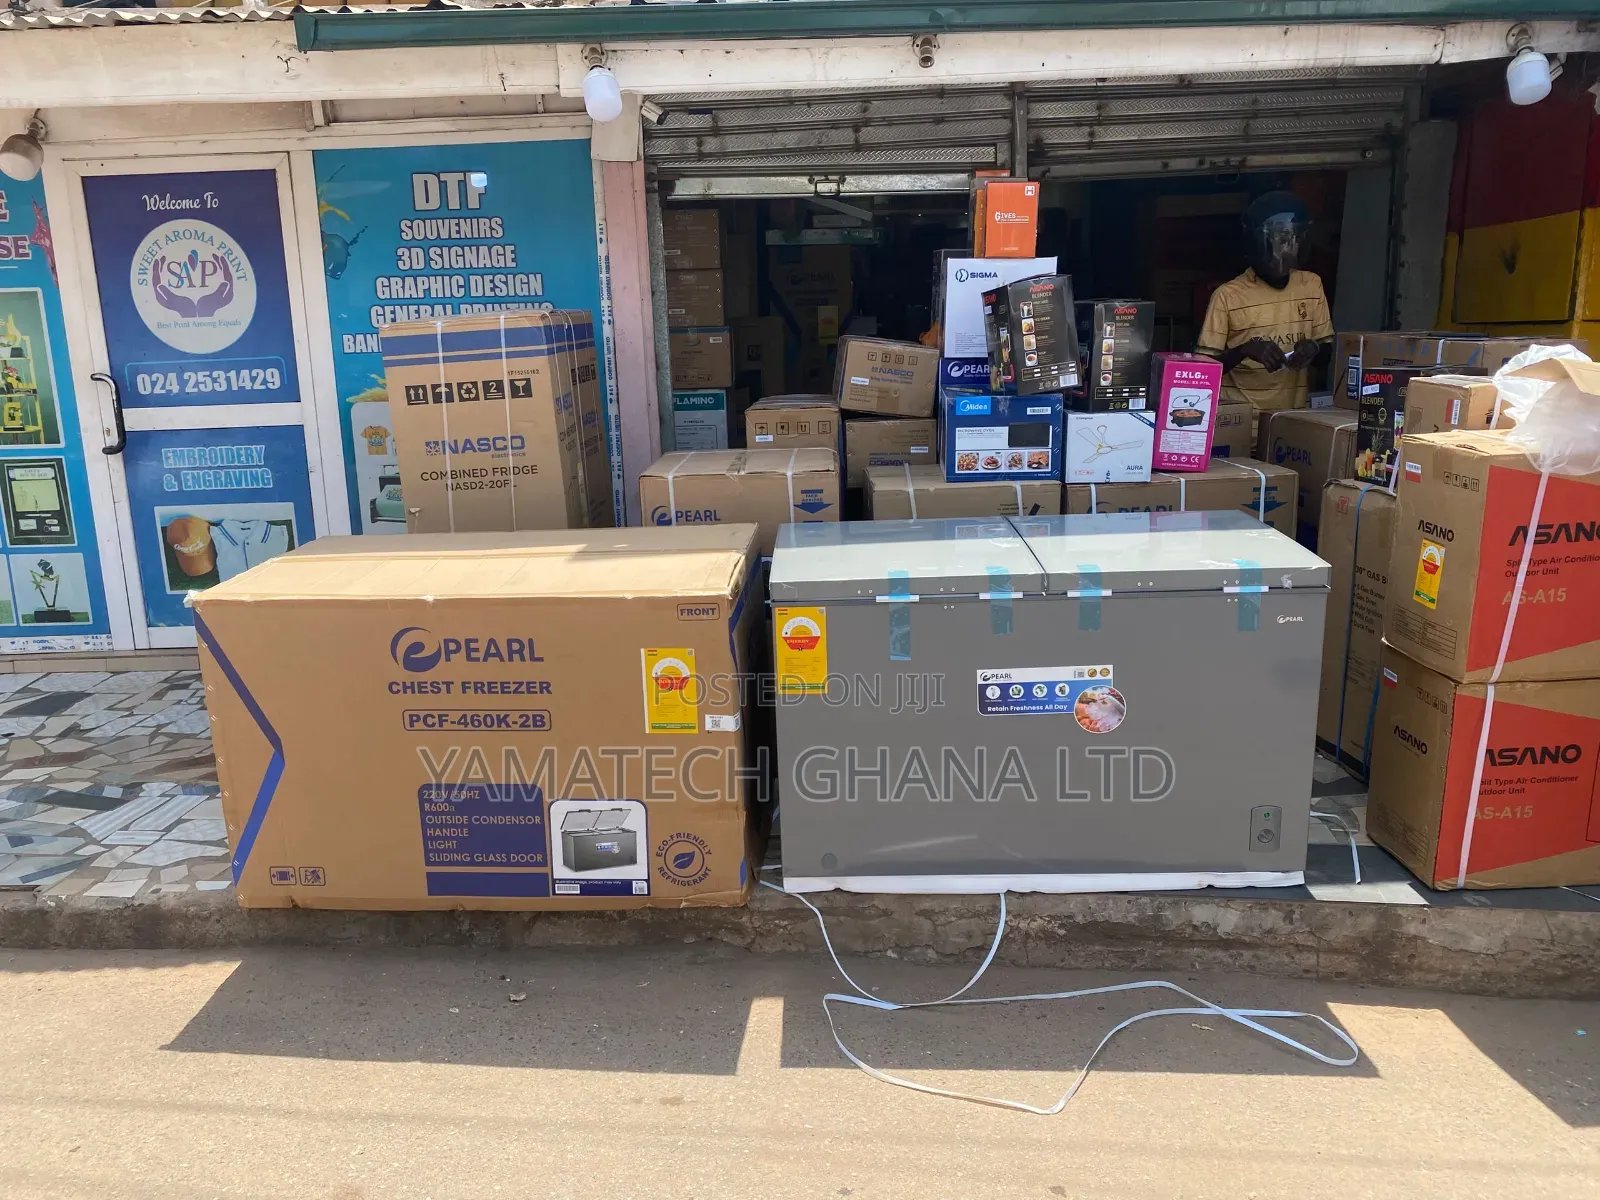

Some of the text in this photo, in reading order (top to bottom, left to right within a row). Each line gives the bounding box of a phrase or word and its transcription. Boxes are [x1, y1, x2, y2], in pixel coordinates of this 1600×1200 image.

[141, 191, 219, 211] Welcome To
[400, 217, 504, 241] SOUVENIRS
[138, 228, 247, 286] SWEET AROMA PRINT
[396, 245, 517, 270] 3D SIGNAGE
[167, 260, 218, 288] SAP
[375, 273, 543, 300] GRAPHIC DESIGN
[1029, 284, 1054, 292] ASANO
[218, 319, 241, 327] Equals
[342, 334, 382, 353] BAN
[879, 367, 914, 377] NASCO
[964, 364, 990, 374] PEAR
[1175, 371, 1201, 379] EXLG
[136, 368, 281, 394] 024 2531429
[1364, 374, 1393, 384] ASANO
[961, 400, 987, 411] Midea
[442, 435, 526, 455] NASCO
[161, 445, 266, 469] EMBROIDERY
[1286, 446, 1312, 466] PEARL
[163, 468, 273, 491] & ENGRAVING
[421, 465, 539, 481] COMBINED FRIDGE
[676, 509, 721, 522] PEARL
[1418, 519, 1455, 542] ASANO
[1367, 570, 1381, 581] GAS
[1542, 567, 1559, 575] Unit
[680, 607, 716, 616] FRONT
[444, 637, 545, 663] PEARL
[388, 681, 552, 695] CHEST FREEZER
[408, 713, 547, 729] PCF-460K-2B
[1394, 725, 1427, 755] ASANO
[1485, 744, 1583, 767] ASANO
[1530, 776, 1579, 784] Conditioner
[423, 790, 448, 799] 220V
[424, 803, 455, 811] R600a
[425, 816, 541, 824] OUTSIDE CONDENSOR
[427, 828, 469, 836] HANDLE
[428, 840, 457, 849] LIGHT
[656, 832, 713, 857] ECO-FRIENDLY
[429, 853, 543, 862] SLIDING GLASS DOOR
[657, 866, 712, 887] REFRIGERANT
